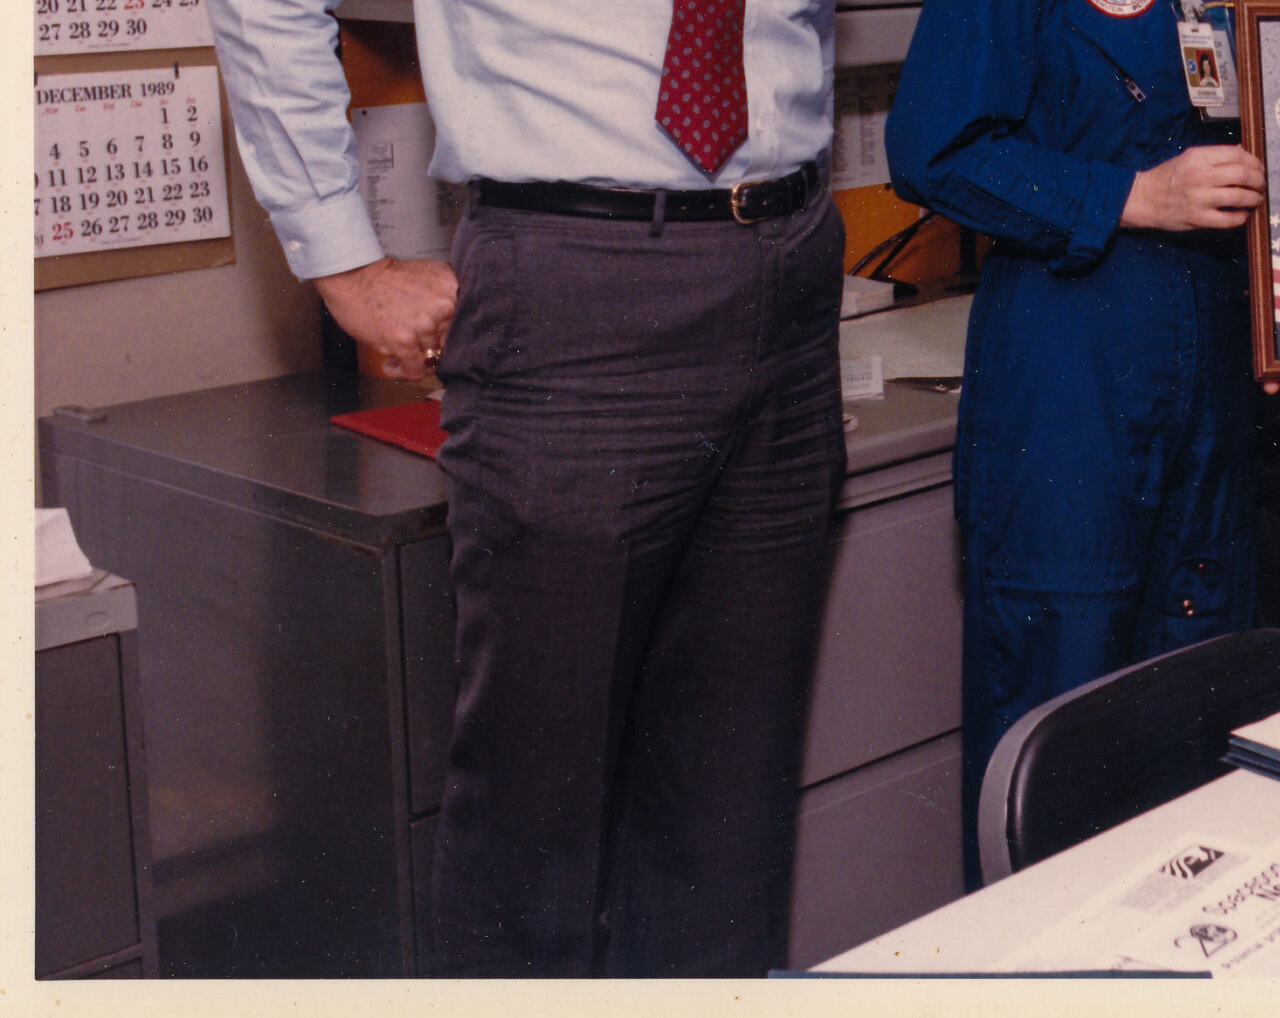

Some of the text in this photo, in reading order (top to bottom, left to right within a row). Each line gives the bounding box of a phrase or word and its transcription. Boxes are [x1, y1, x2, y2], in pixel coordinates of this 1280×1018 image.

[39, 19, 147, 41] 27 28 29 30
[37, 82, 175, 104] DECEMBER 1989
[161, 106, 197, 124] 1 2
[49, 131, 200, 160] 4 5 6 7 8 9
[48, 169, 66, 186] 11
[78, 166, 97, 184] 12
[106, 164, 125, 181] 13
[133, 162, 153, 178] 14
[161, 159, 181, 176] 15
[190, 156, 208, 172] 16
[51, 196, 71, 213] 18
[80, 193, 99, 210] 19
[107, 190, 128, 207] 20
[134, 187, 154, 205] 21
[163, 184, 183, 201] 22
[190, 182, 210, 199] 23
[52, 222, 74, 240] 25
[81, 219, 102, 236] 26
[109, 216, 129, 233] 27
[137, 213, 158, 230] 28
[166, 210, 186, 227] 29
[193, 207, 213, 223] 30
